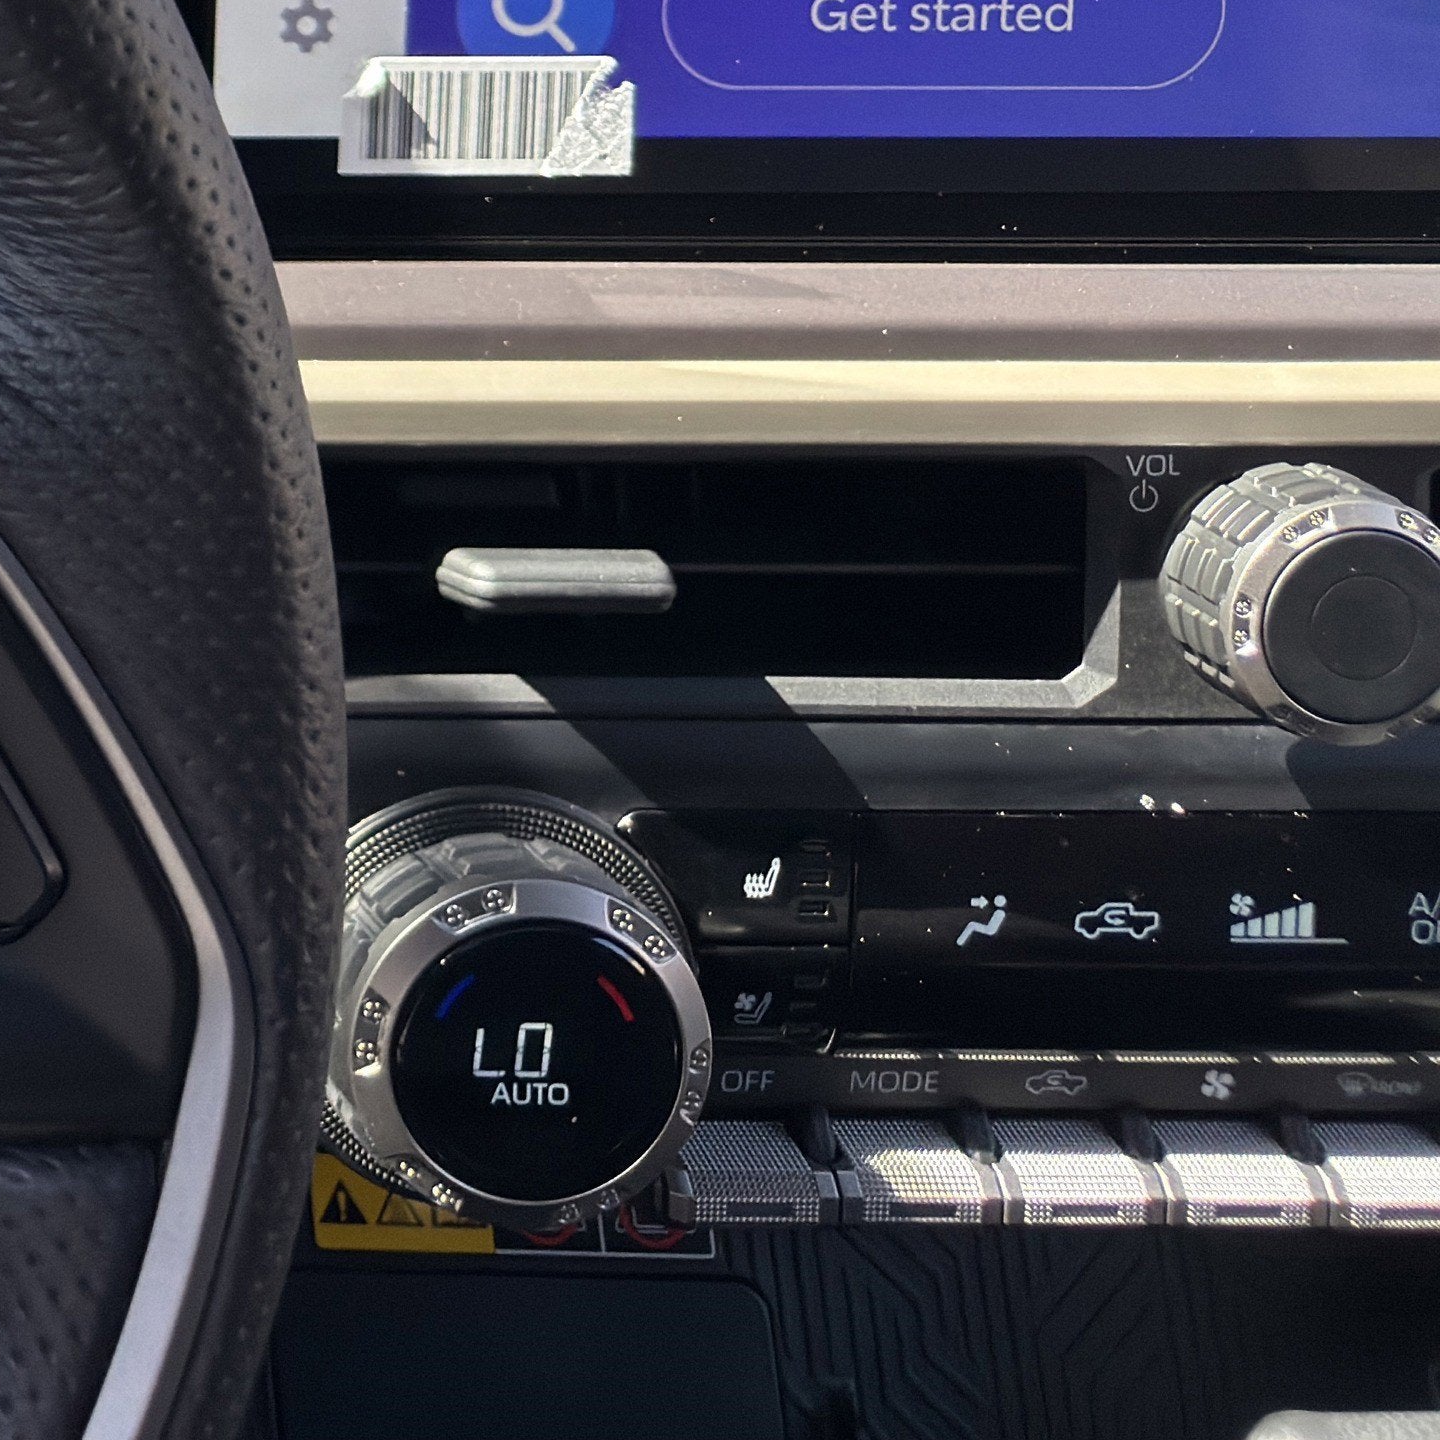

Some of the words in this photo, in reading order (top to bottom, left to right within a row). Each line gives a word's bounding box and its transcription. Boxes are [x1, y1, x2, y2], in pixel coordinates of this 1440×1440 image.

[1126, 454, 1180, 476] VOL
[473, 1022, 553, 1078] LO
[720, 1070, 775, 1093] OFF
[849, 1070, 940, 1093] MODE
[490, 1082, 570, 1105] AUTO
